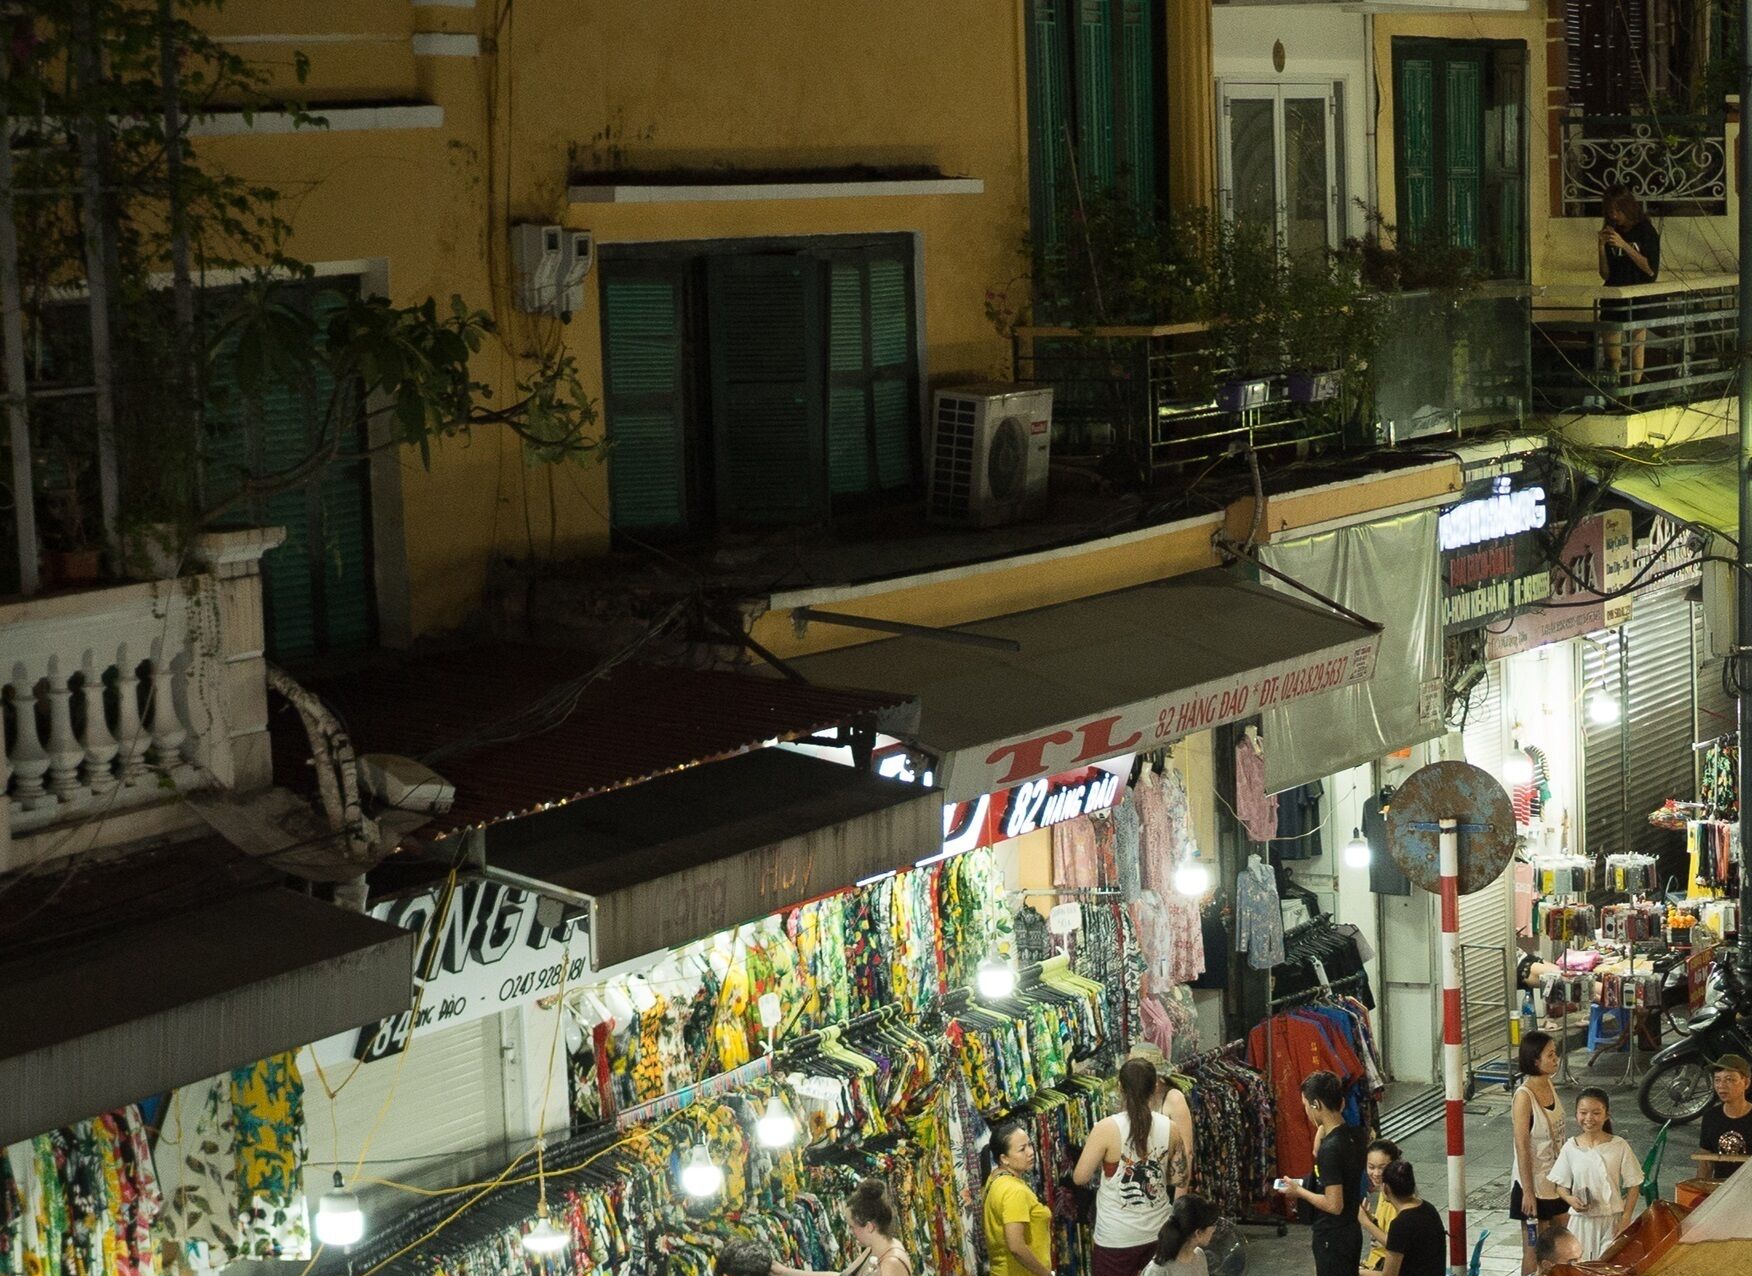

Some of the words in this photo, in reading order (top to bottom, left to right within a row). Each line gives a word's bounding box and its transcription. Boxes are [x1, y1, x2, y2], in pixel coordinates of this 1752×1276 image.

[985, 714, 1142, 784] TL
[1153, 707, 1175, 739] 82
[1006, 776, 1049, 839] 82
